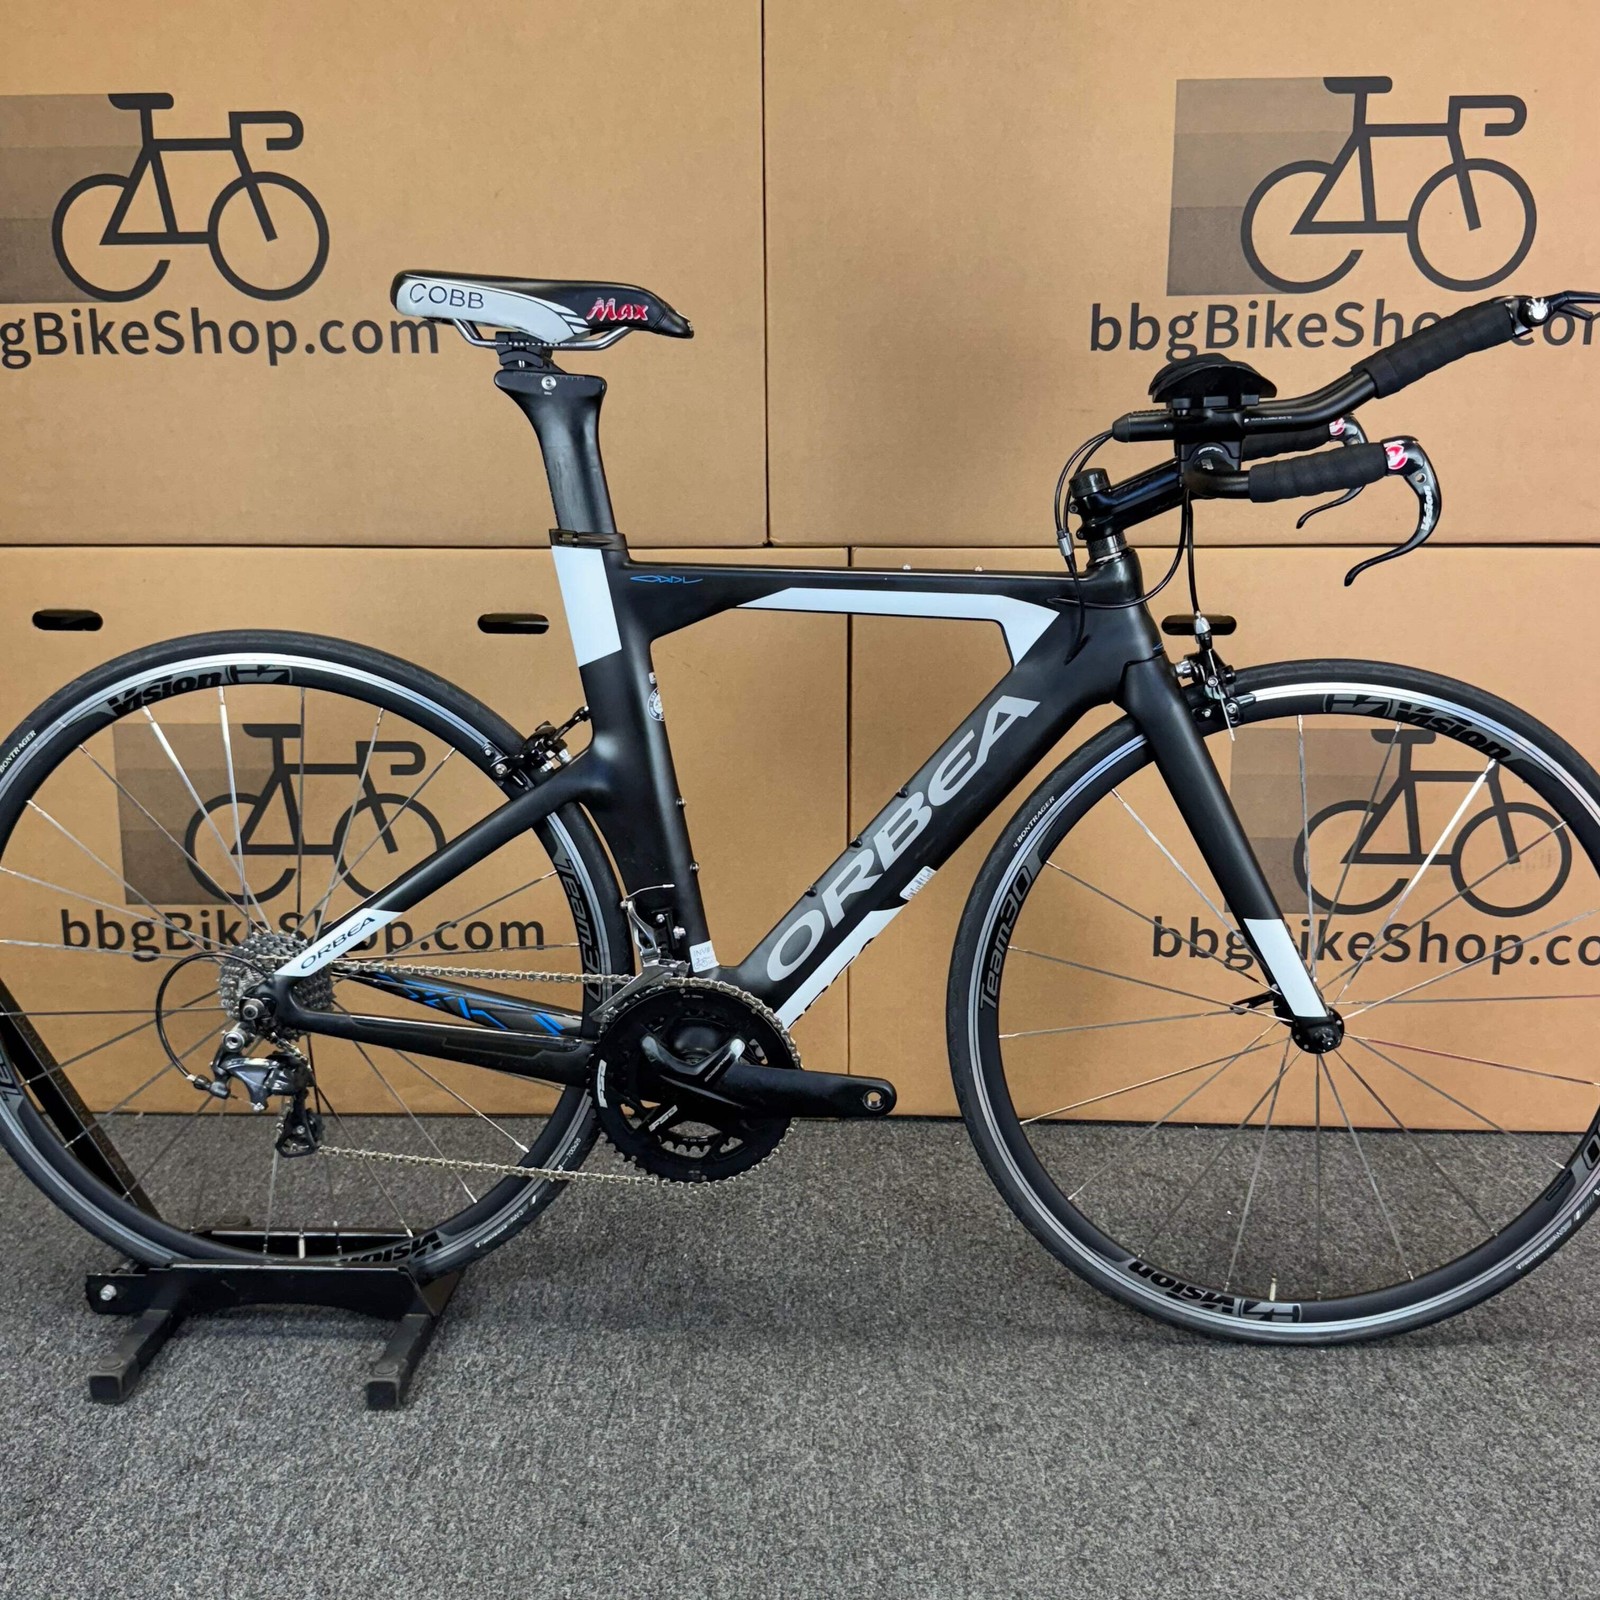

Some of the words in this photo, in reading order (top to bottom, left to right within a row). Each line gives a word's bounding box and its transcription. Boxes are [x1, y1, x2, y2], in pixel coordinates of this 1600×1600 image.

[409, 282, 485, 310] COBB
[586, 297, 649, 322] Max
[767, 695, 1041, 982] ORBEA
[1017, 796, 1056, 843] BONTRAGER
[301, 917, 375, 969] ORBEA
